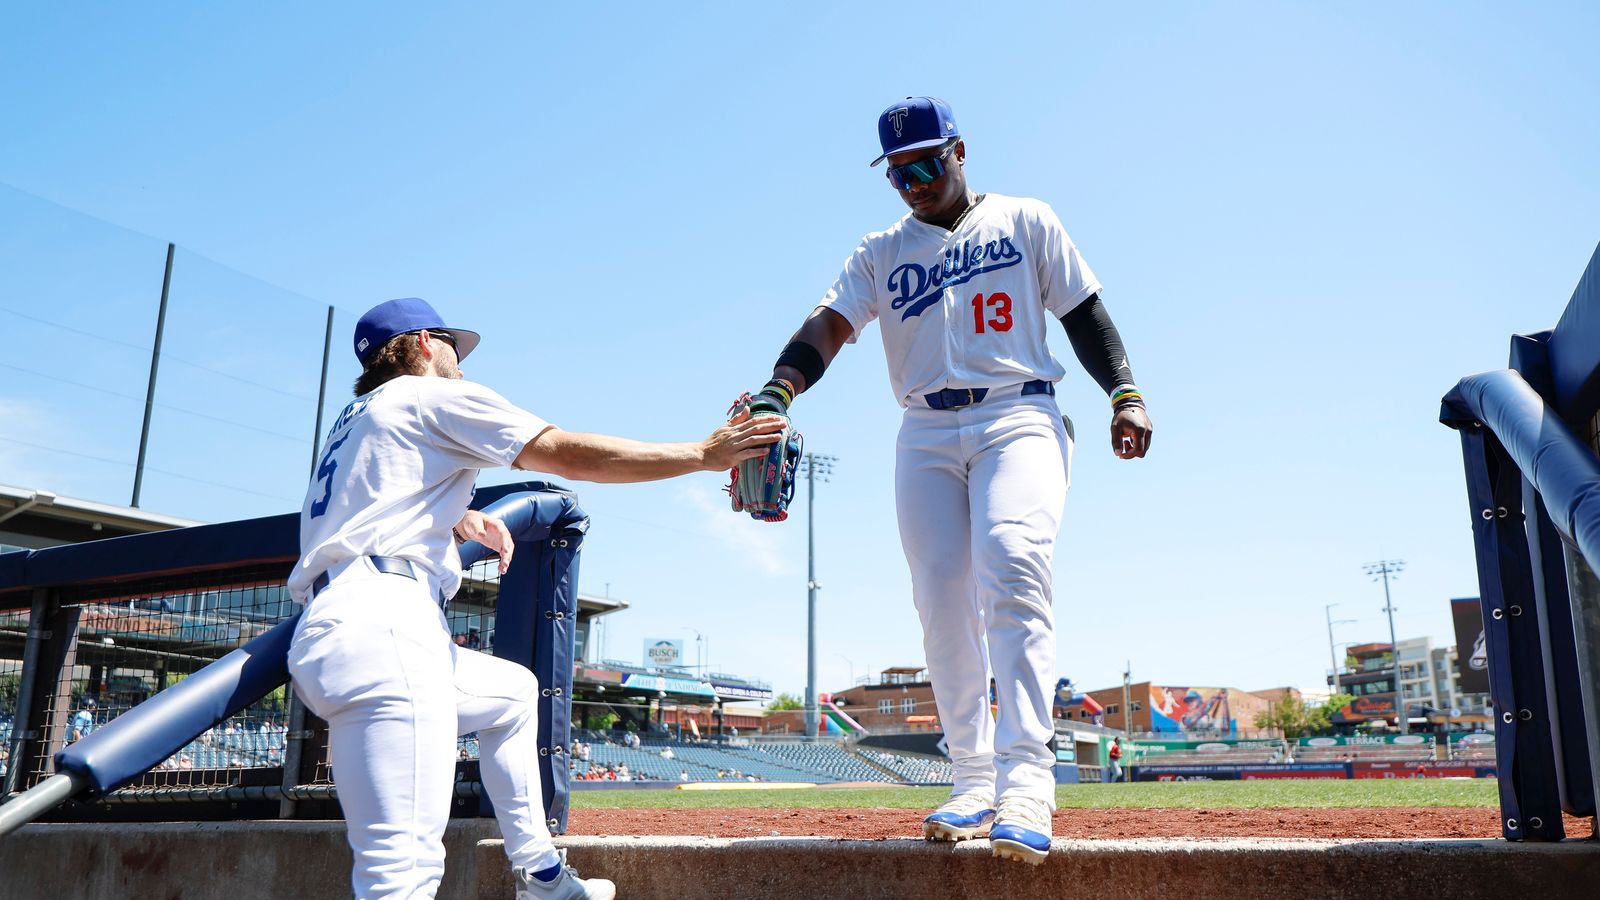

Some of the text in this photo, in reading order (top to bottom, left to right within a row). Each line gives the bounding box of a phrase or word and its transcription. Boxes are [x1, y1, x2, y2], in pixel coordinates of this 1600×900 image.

[887, 236, 1022, 314] Drillers
[971, 292, 1013, 334] 13
[310, 428, 352, 519] 5
[87, 615, 227, 639] AROUND THE DAMOND
[648, 647, 679, 658] BUSCH
[1344, 736, 1386, 745] TERRACE
